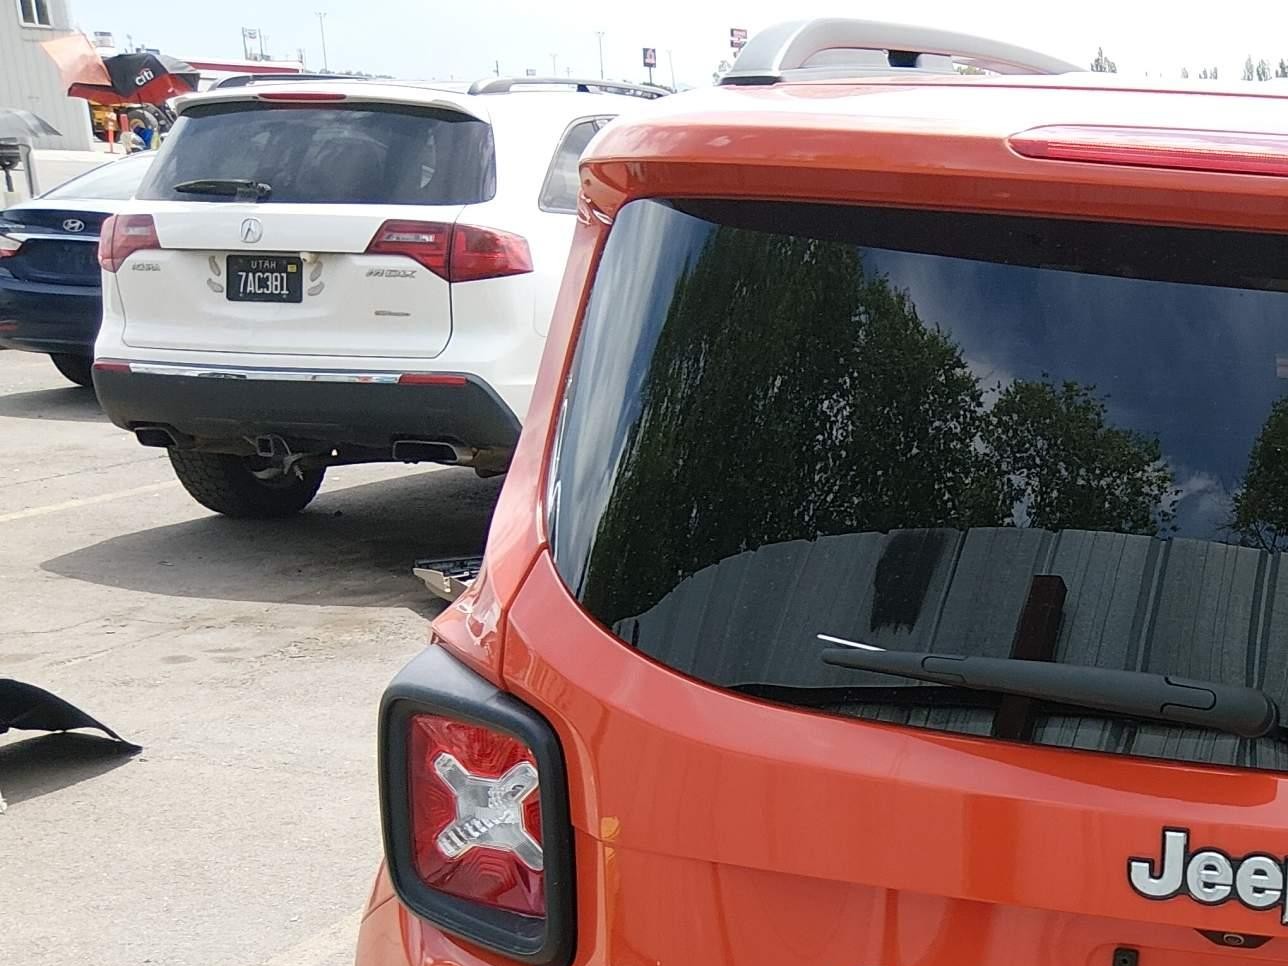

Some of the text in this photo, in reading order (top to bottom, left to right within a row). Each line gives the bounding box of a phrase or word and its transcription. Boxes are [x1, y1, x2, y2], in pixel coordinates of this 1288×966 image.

[135, 69, 154, 86] citi
[251, 260, 277, 269] UTAH
[237, 271, 289, 295] 7AC381
